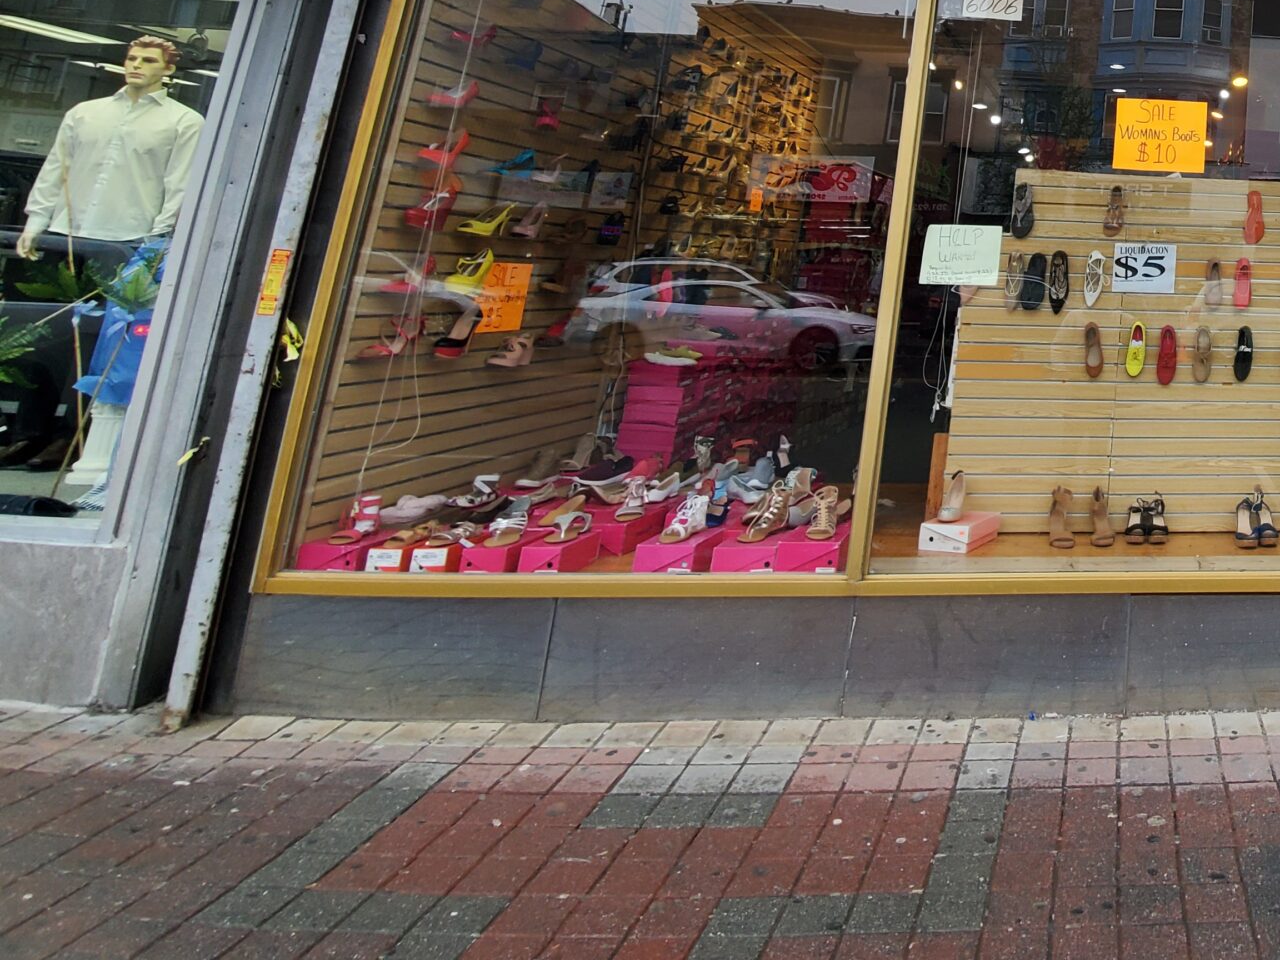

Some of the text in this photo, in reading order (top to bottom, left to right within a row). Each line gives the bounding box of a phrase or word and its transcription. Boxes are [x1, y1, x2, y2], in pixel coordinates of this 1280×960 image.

[1136, 100, 1176, 124] SALE
[1136, 142, 1177, 164] $10
[1120, 246, 1169, 256] LIQUIDACION
[1114, 255, 1166, 280] $5
